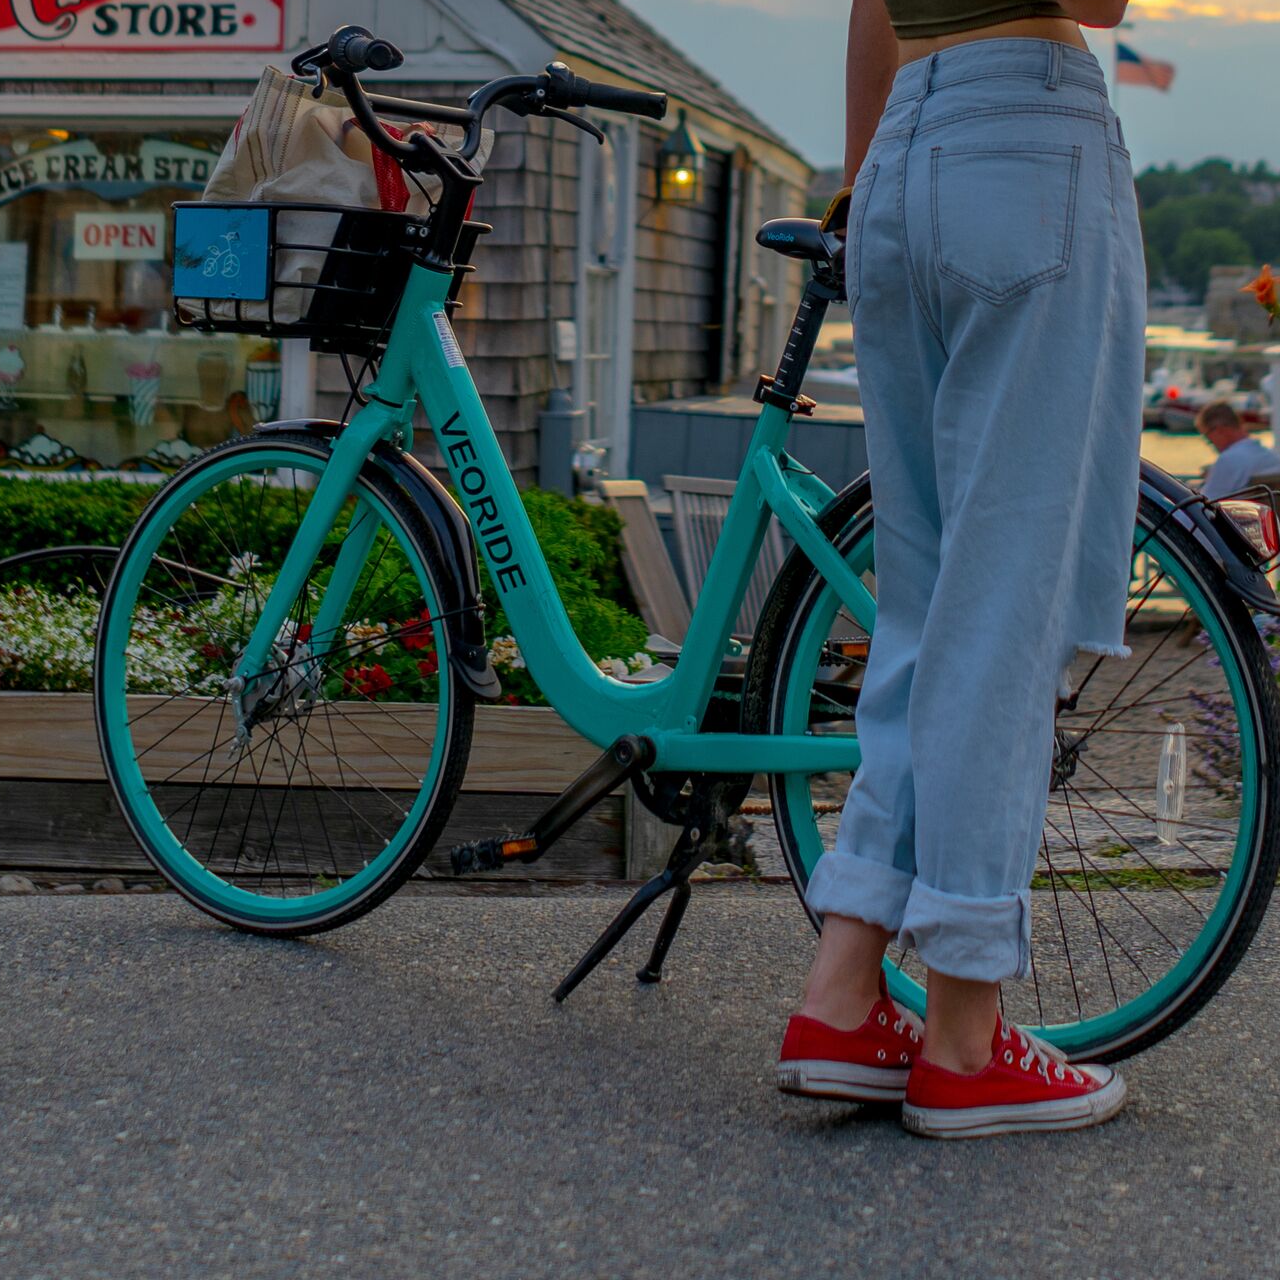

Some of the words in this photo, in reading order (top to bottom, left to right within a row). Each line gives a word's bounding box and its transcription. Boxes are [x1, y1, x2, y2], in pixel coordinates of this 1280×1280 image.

[92, 2, 239, 37] STORE
[45, 153, 146, 181] CREAM
[154, 155, 217, 182] STO
[83, 223, 157, 249] OPEN
[767, 231, 795, 243] VeoRide
[440, 410, 527, 594] VEORIDE
